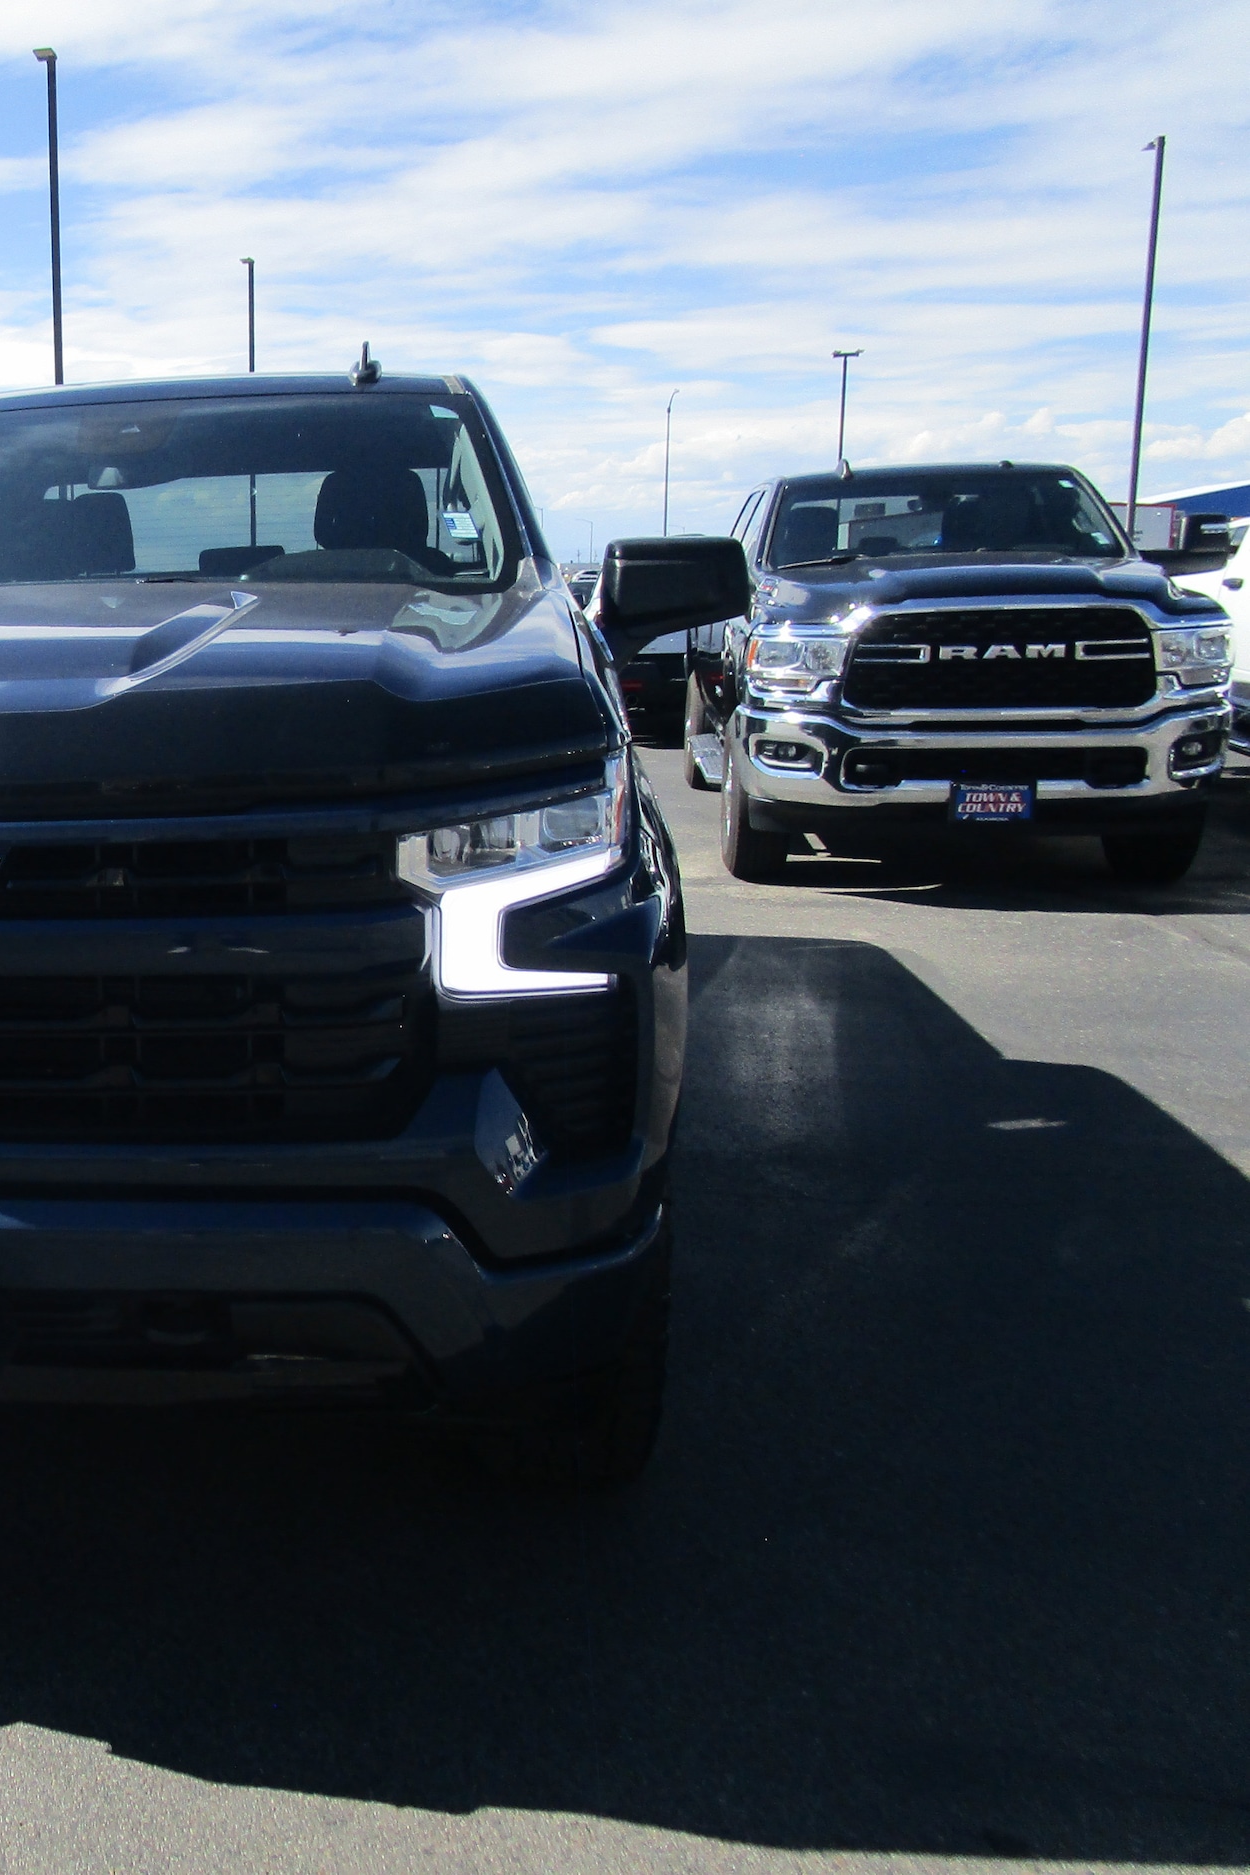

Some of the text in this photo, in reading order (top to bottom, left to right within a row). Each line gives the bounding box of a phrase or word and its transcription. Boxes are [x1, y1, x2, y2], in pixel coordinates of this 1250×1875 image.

[939, 644, 1065, 660] RAM
[965, 792, 1021, 802] TOWN &
[957, 803, 1026, 813] COUNTRY
